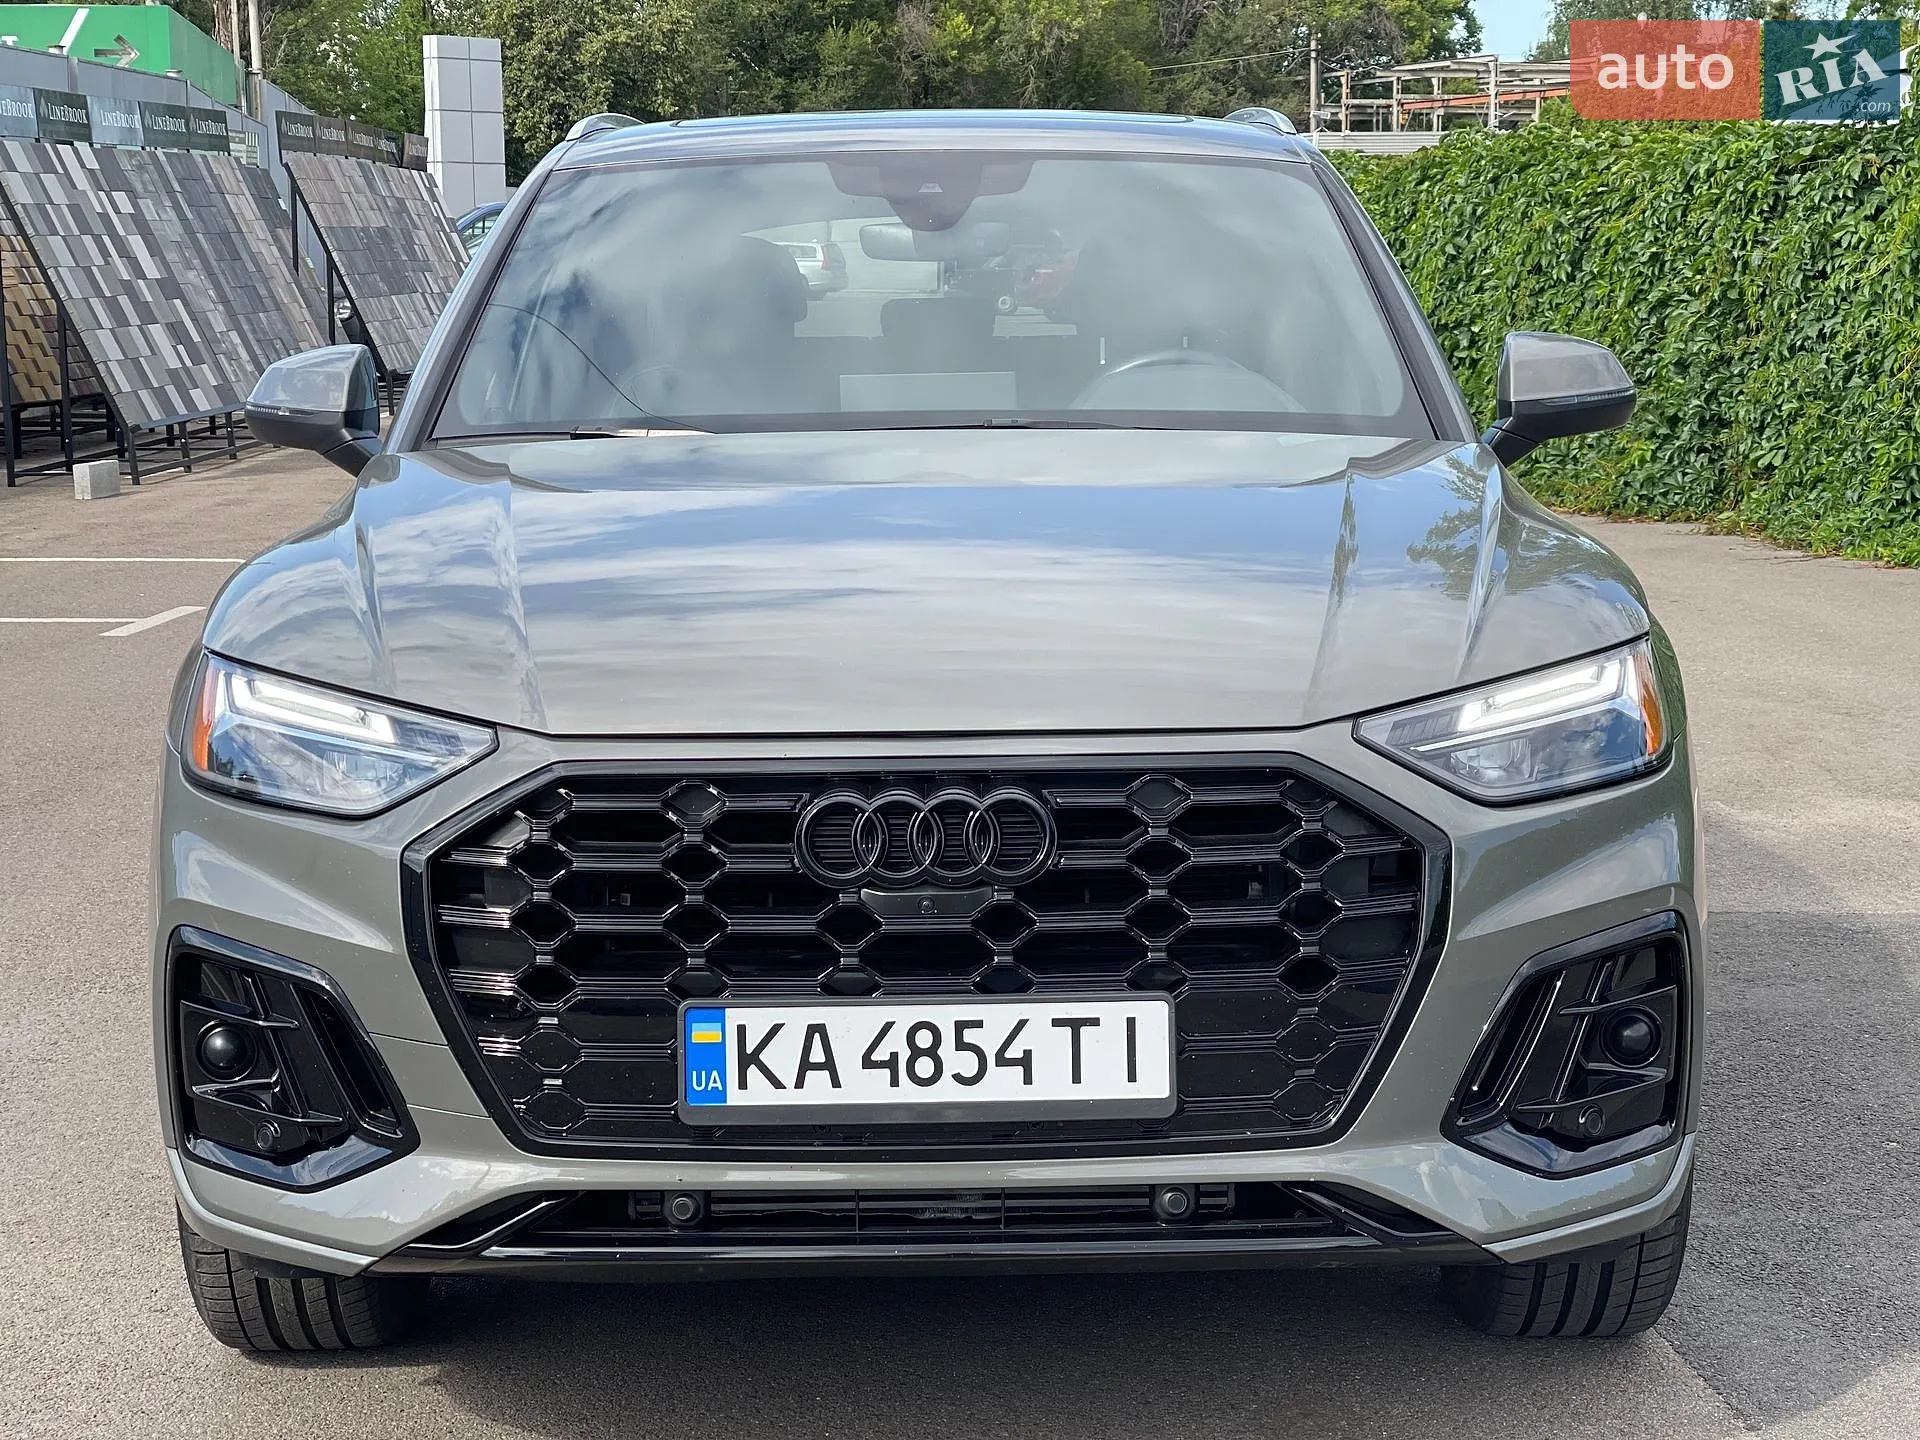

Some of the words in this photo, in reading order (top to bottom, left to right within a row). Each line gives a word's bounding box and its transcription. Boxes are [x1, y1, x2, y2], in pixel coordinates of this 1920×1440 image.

[736, 1022, 842, 1090] KA
[861, 1018, 1033, 1088] 4854
[1051, 1016, 1137, 1084] TI
[692, 1070, 723, 1091] UA
